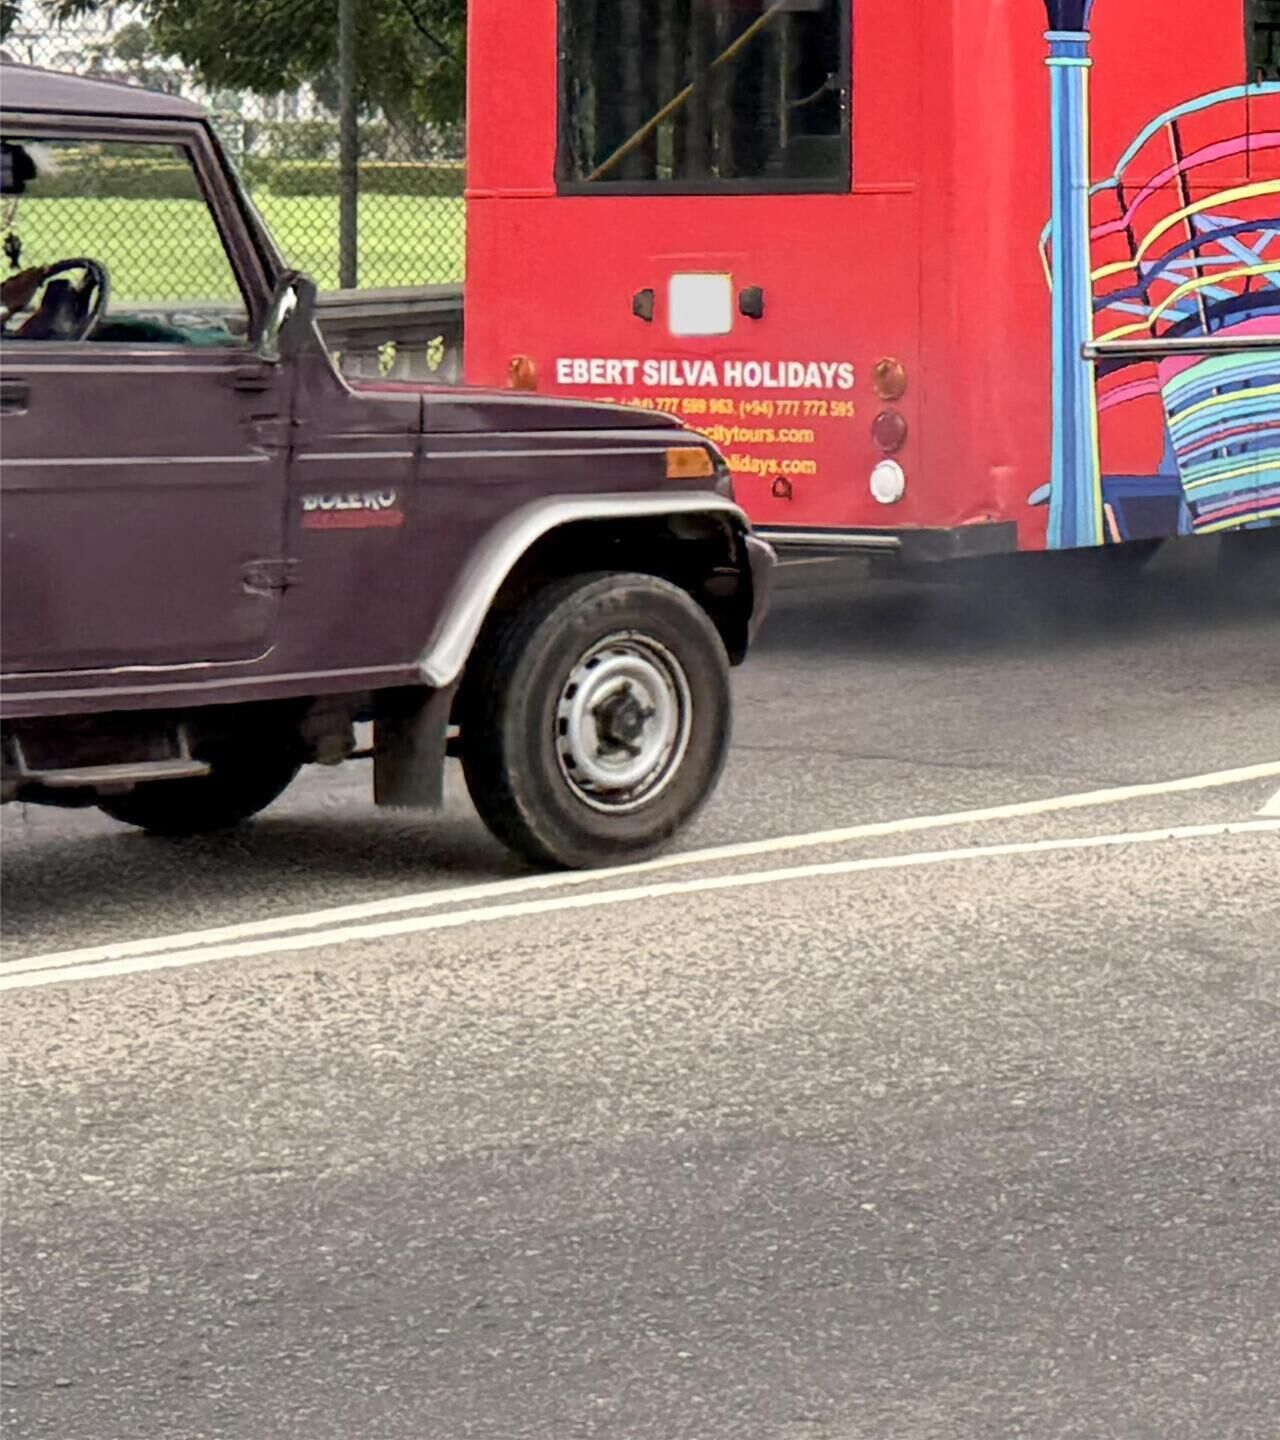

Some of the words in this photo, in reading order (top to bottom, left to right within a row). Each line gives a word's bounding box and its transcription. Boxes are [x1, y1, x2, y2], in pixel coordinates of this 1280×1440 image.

[556, 358, 638, 386] EBERT
[643, 359, 717, 388] SILVA
[724, 361, 855, 390] HOLIDAYS
[302, 488, 397, 511] BOLERO
